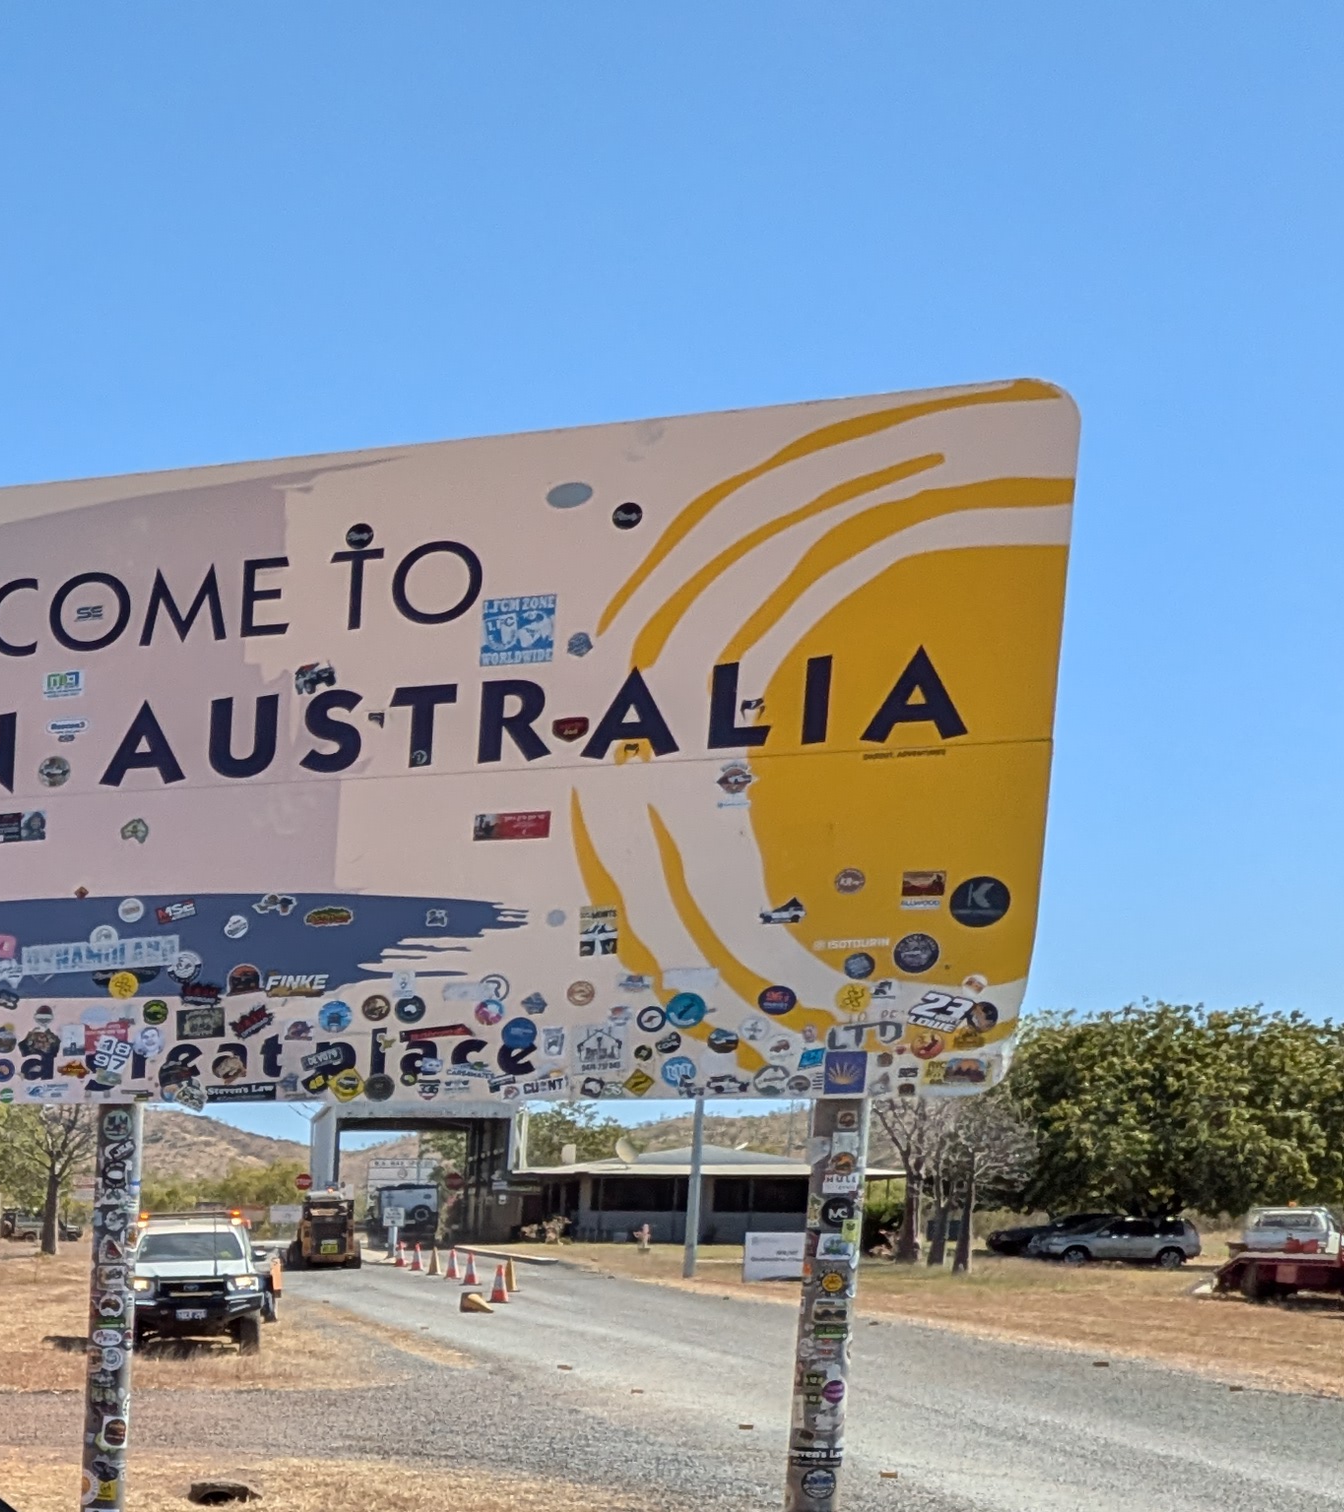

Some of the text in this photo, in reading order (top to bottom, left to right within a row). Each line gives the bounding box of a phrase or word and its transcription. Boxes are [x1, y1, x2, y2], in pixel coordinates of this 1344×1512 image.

[330, 540, 483, 631] TO
[99, 645, 968, 786] AUSTRALIA
[266, 974, 329, 990] FINKE
[911, 991, 975, 1019] 23
[908, 1016, 956, 1033] LOWE
[208, 1085, 249, 1095] Steven's
